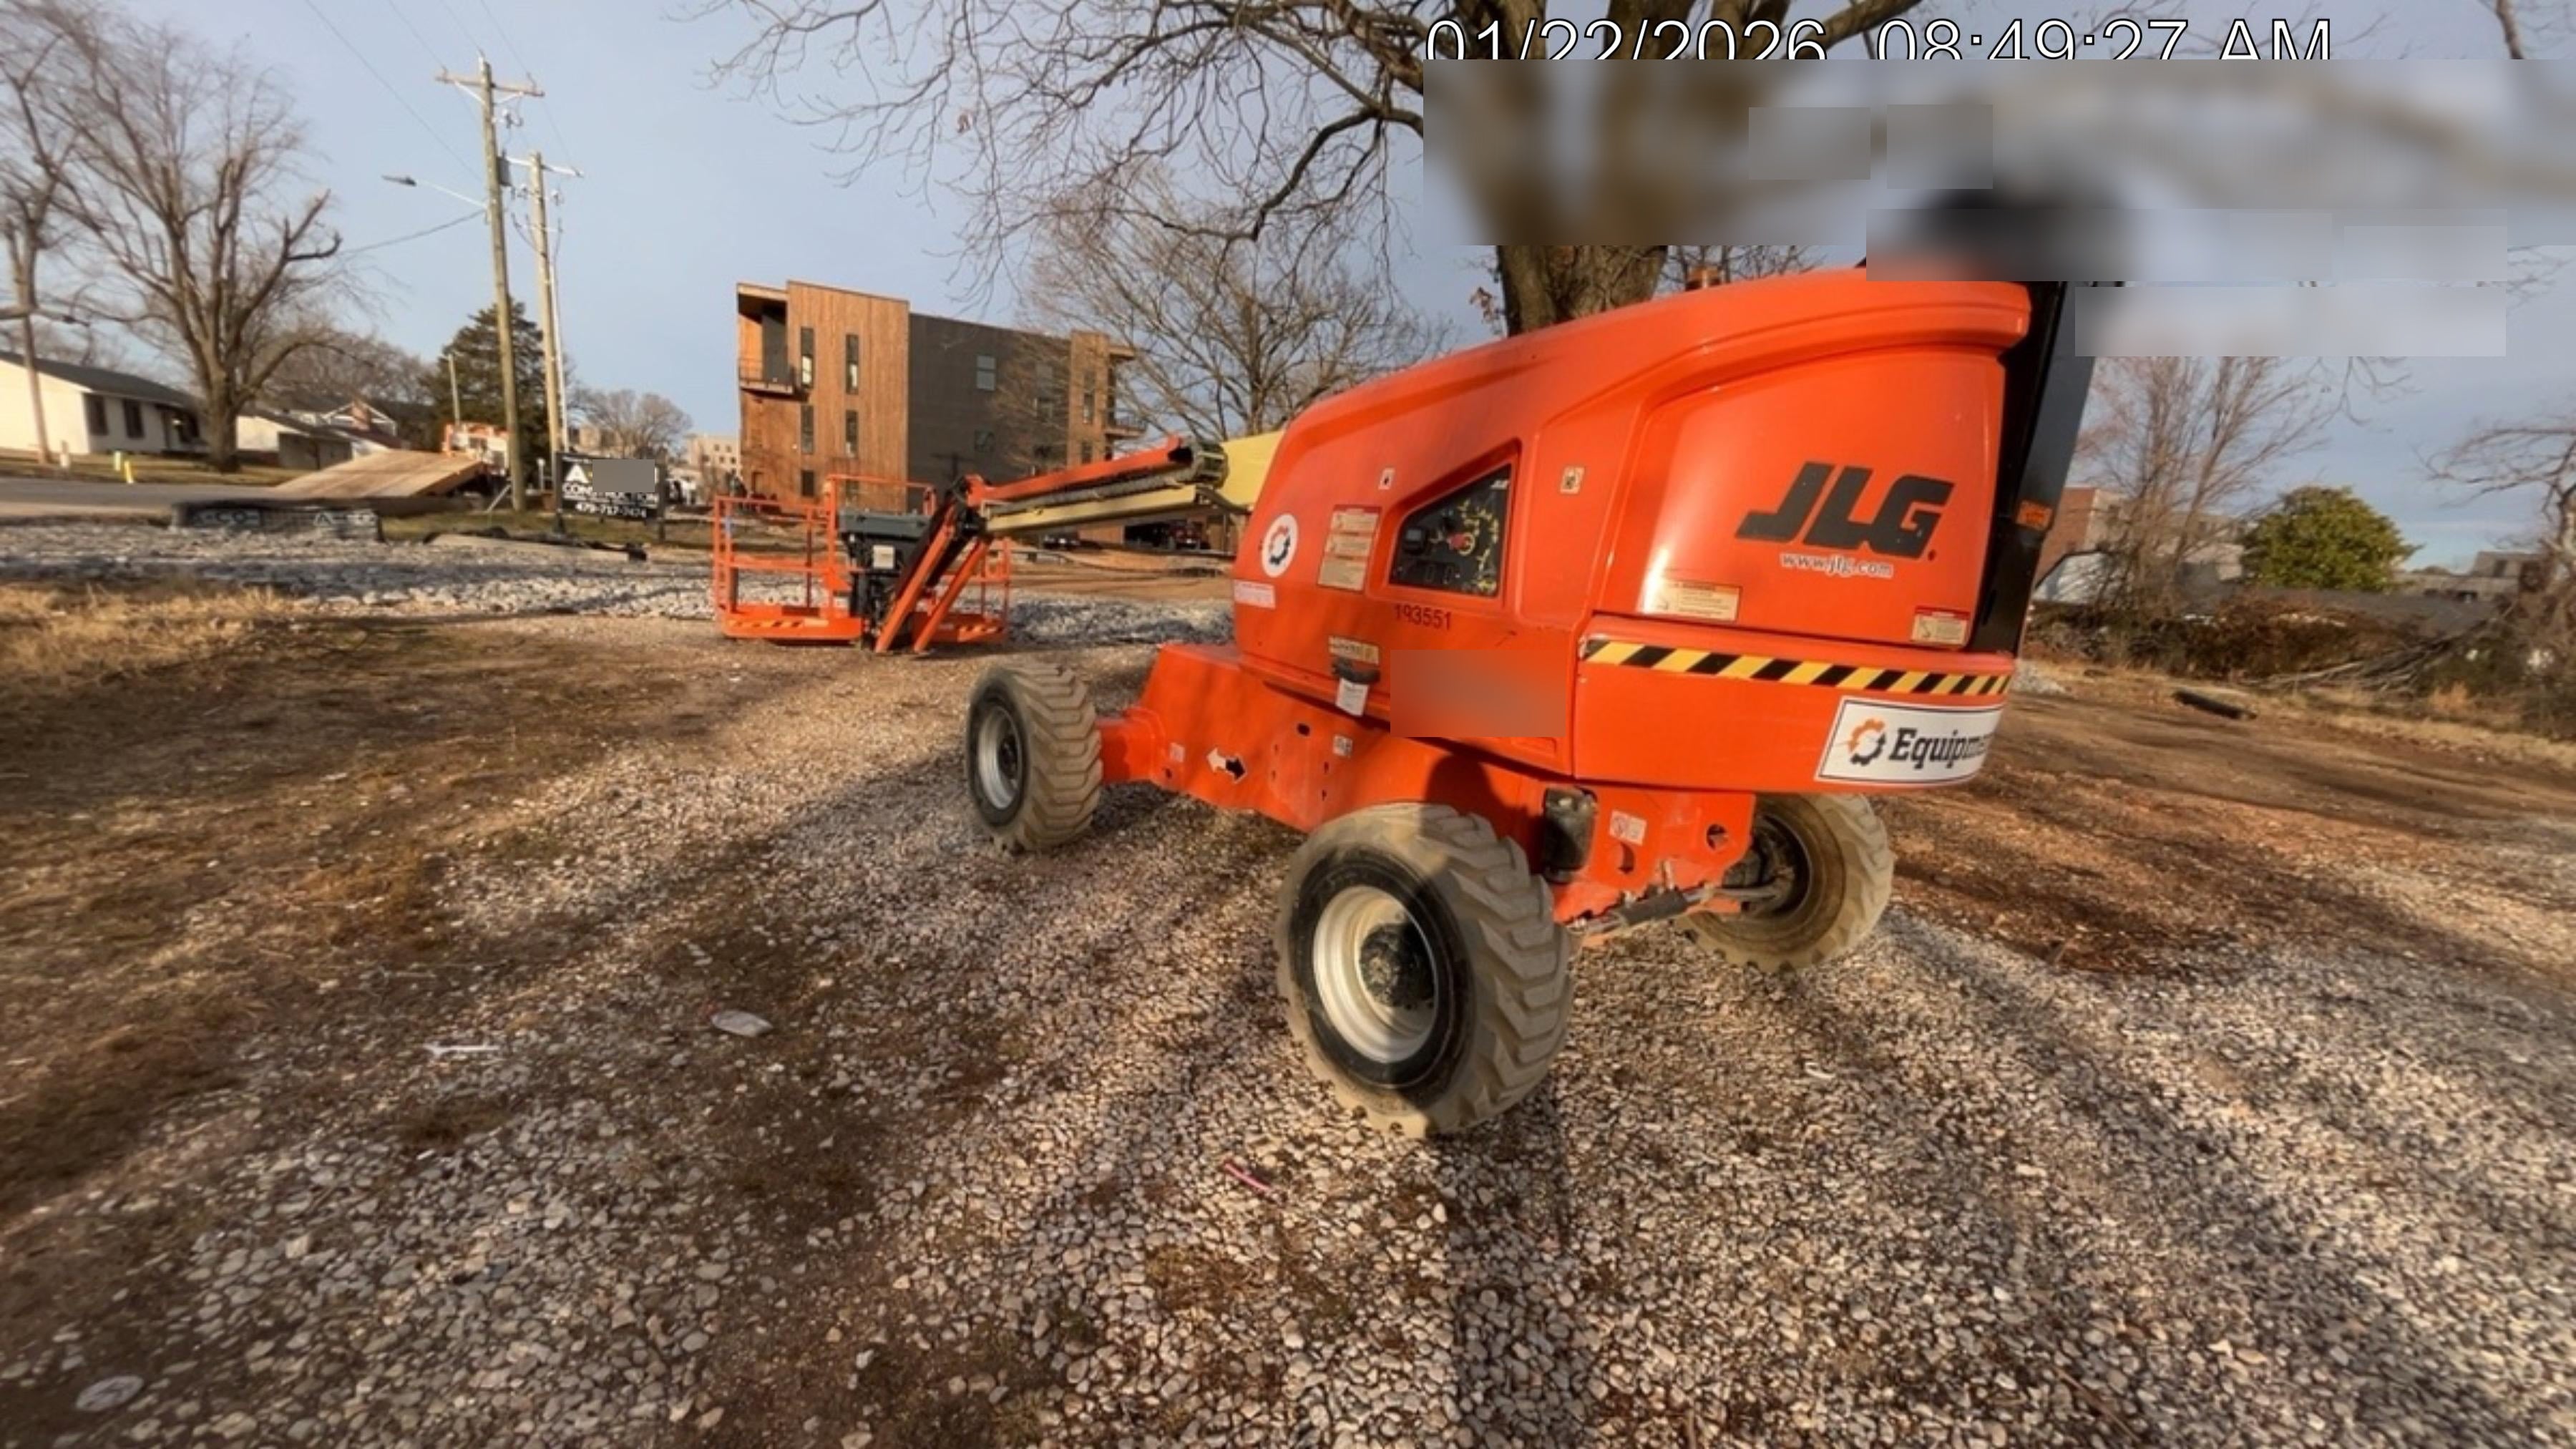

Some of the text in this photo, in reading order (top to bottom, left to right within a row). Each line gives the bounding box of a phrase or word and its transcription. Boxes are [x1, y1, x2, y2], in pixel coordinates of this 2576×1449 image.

[1735, 461, 1955, 560] JLG
[1781, 552, 1893, 577] www.jlg.com
[1394, 604, 1453, 632] 193551
